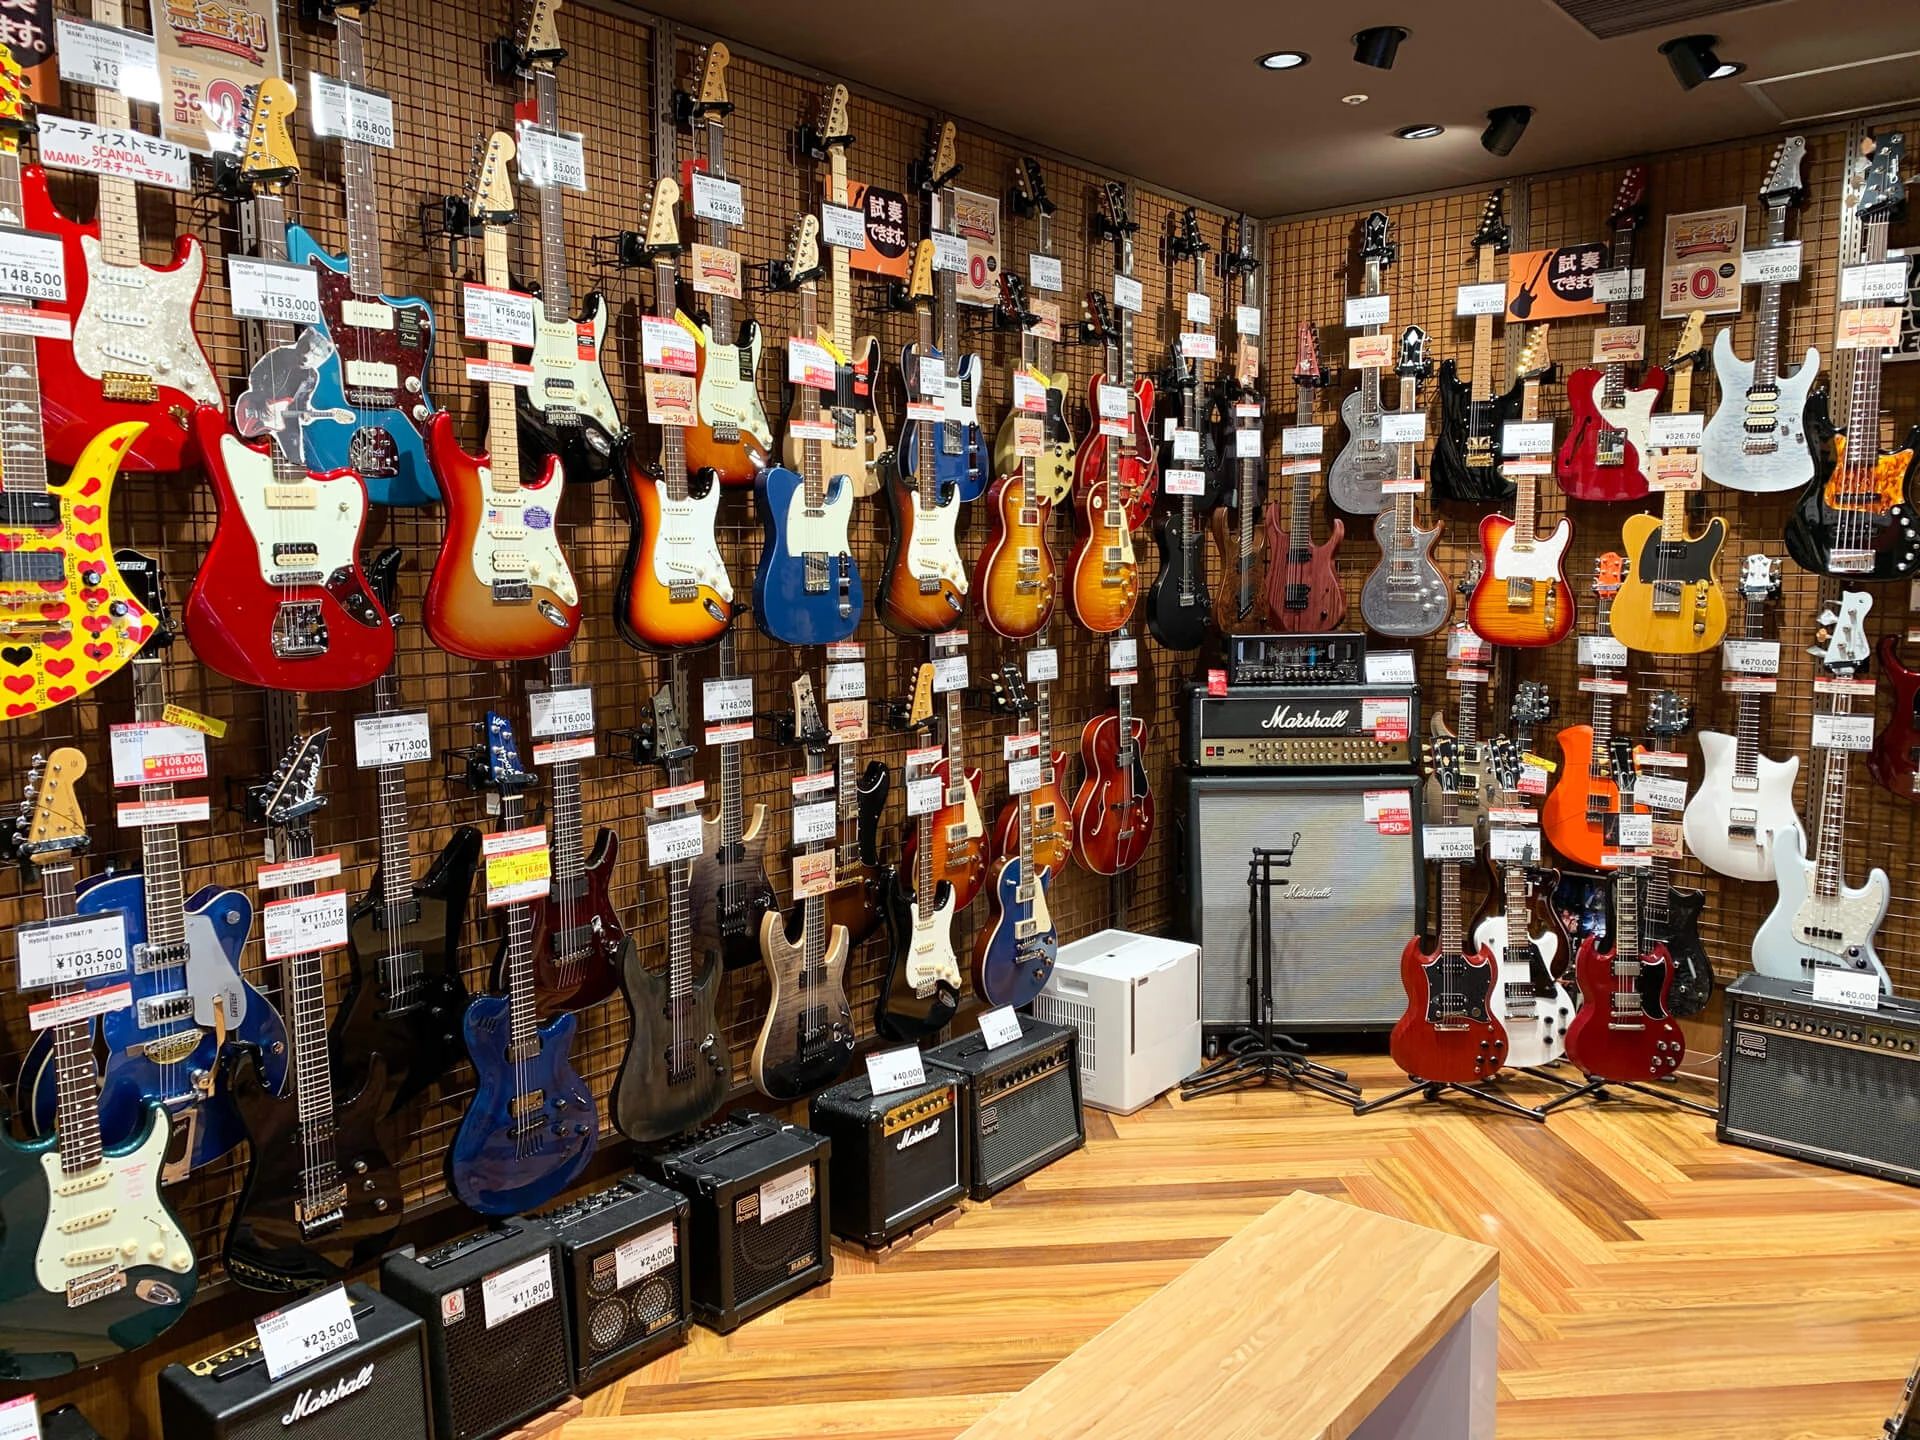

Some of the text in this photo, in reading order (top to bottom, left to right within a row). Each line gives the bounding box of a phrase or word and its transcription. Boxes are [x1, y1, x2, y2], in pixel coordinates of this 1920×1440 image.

[340, 115, 391, 137] ¥49,800
[41, 119, 187, 161] アーティストモデル
[92, 145, 147, 165] SCANDAL
[709, 201, 741, 216] ¥249,800
[869, 196, 903, 224] 試奏
[867, 222, 906, 247] できます。
[1558, 250, 1600, 273] 試奏
[1759, 264, 1798, 275] ¥556,000
[11, 283, 61, 298] ¥160,380
[1609, 286, 1643, 295] ¥303,20
[1671, 282, 1688, 294] 36
[261, 294, 317, 312] ¥153,000
[279, 310, 317, 322] ¥165,240
[496, 306, 531, 320] ¥156,000
[1665, 432, 1701, 440] ¥326,760
[1593, 653, 1625, 661] ¥369,000
[1740, 658, 1777, 667] ¥670,000
[720, 699, 752, 711] ¥148,000
[551, 712, 591, 725] ¥116,000
[1261, 705, 1350, 729] Marshall
[114, 730, 149, 739] GRETSCH
[1831, 734, 1871, 743] ¥325,100
[388, 738, 428, 753] ¥71,300
[156, 754, 203, 768] ¥108,000
[1649, 792, 1684, 805] ¥425,000
[808, 821, 835, 833] ¥152,000
[666, 838, 701, 853] ¥132,000
[1440, 844, 1473, 852] ¥104,200
[1283, 883, 1333, 898] Marshall
[302, 907, 345, 924] ¥111,112
[313, 918, 344, 930] ¥120,000
[22, 930, 48, 939] Fender
[56, 947, 123, 970] ¥103,500
[75, 961, 123, 977] ¥111,780
[1840, 990, 1877, 1002] ¥60,000
[1735, 1046, 1766, 1059] Roland
[893, 1067, 922, 1081] ¥40,000
[896, 1117, 941, 1151] Marshall
[780, 1187, 809, 1205] ¥22,500
[736, 1208, 759, 1224] Roland
[640, 1246, 673, 1267] ¥24,000
[512, 1280, 550, 1304] ¥11,800
[260, 1315, 287, 1331] Marshall
[302, 1318, 352, 1348] ¥23,500
[319, 1331, 354, 1352] ¥25,380
[281, 1362, 375, 1426] Marshall
